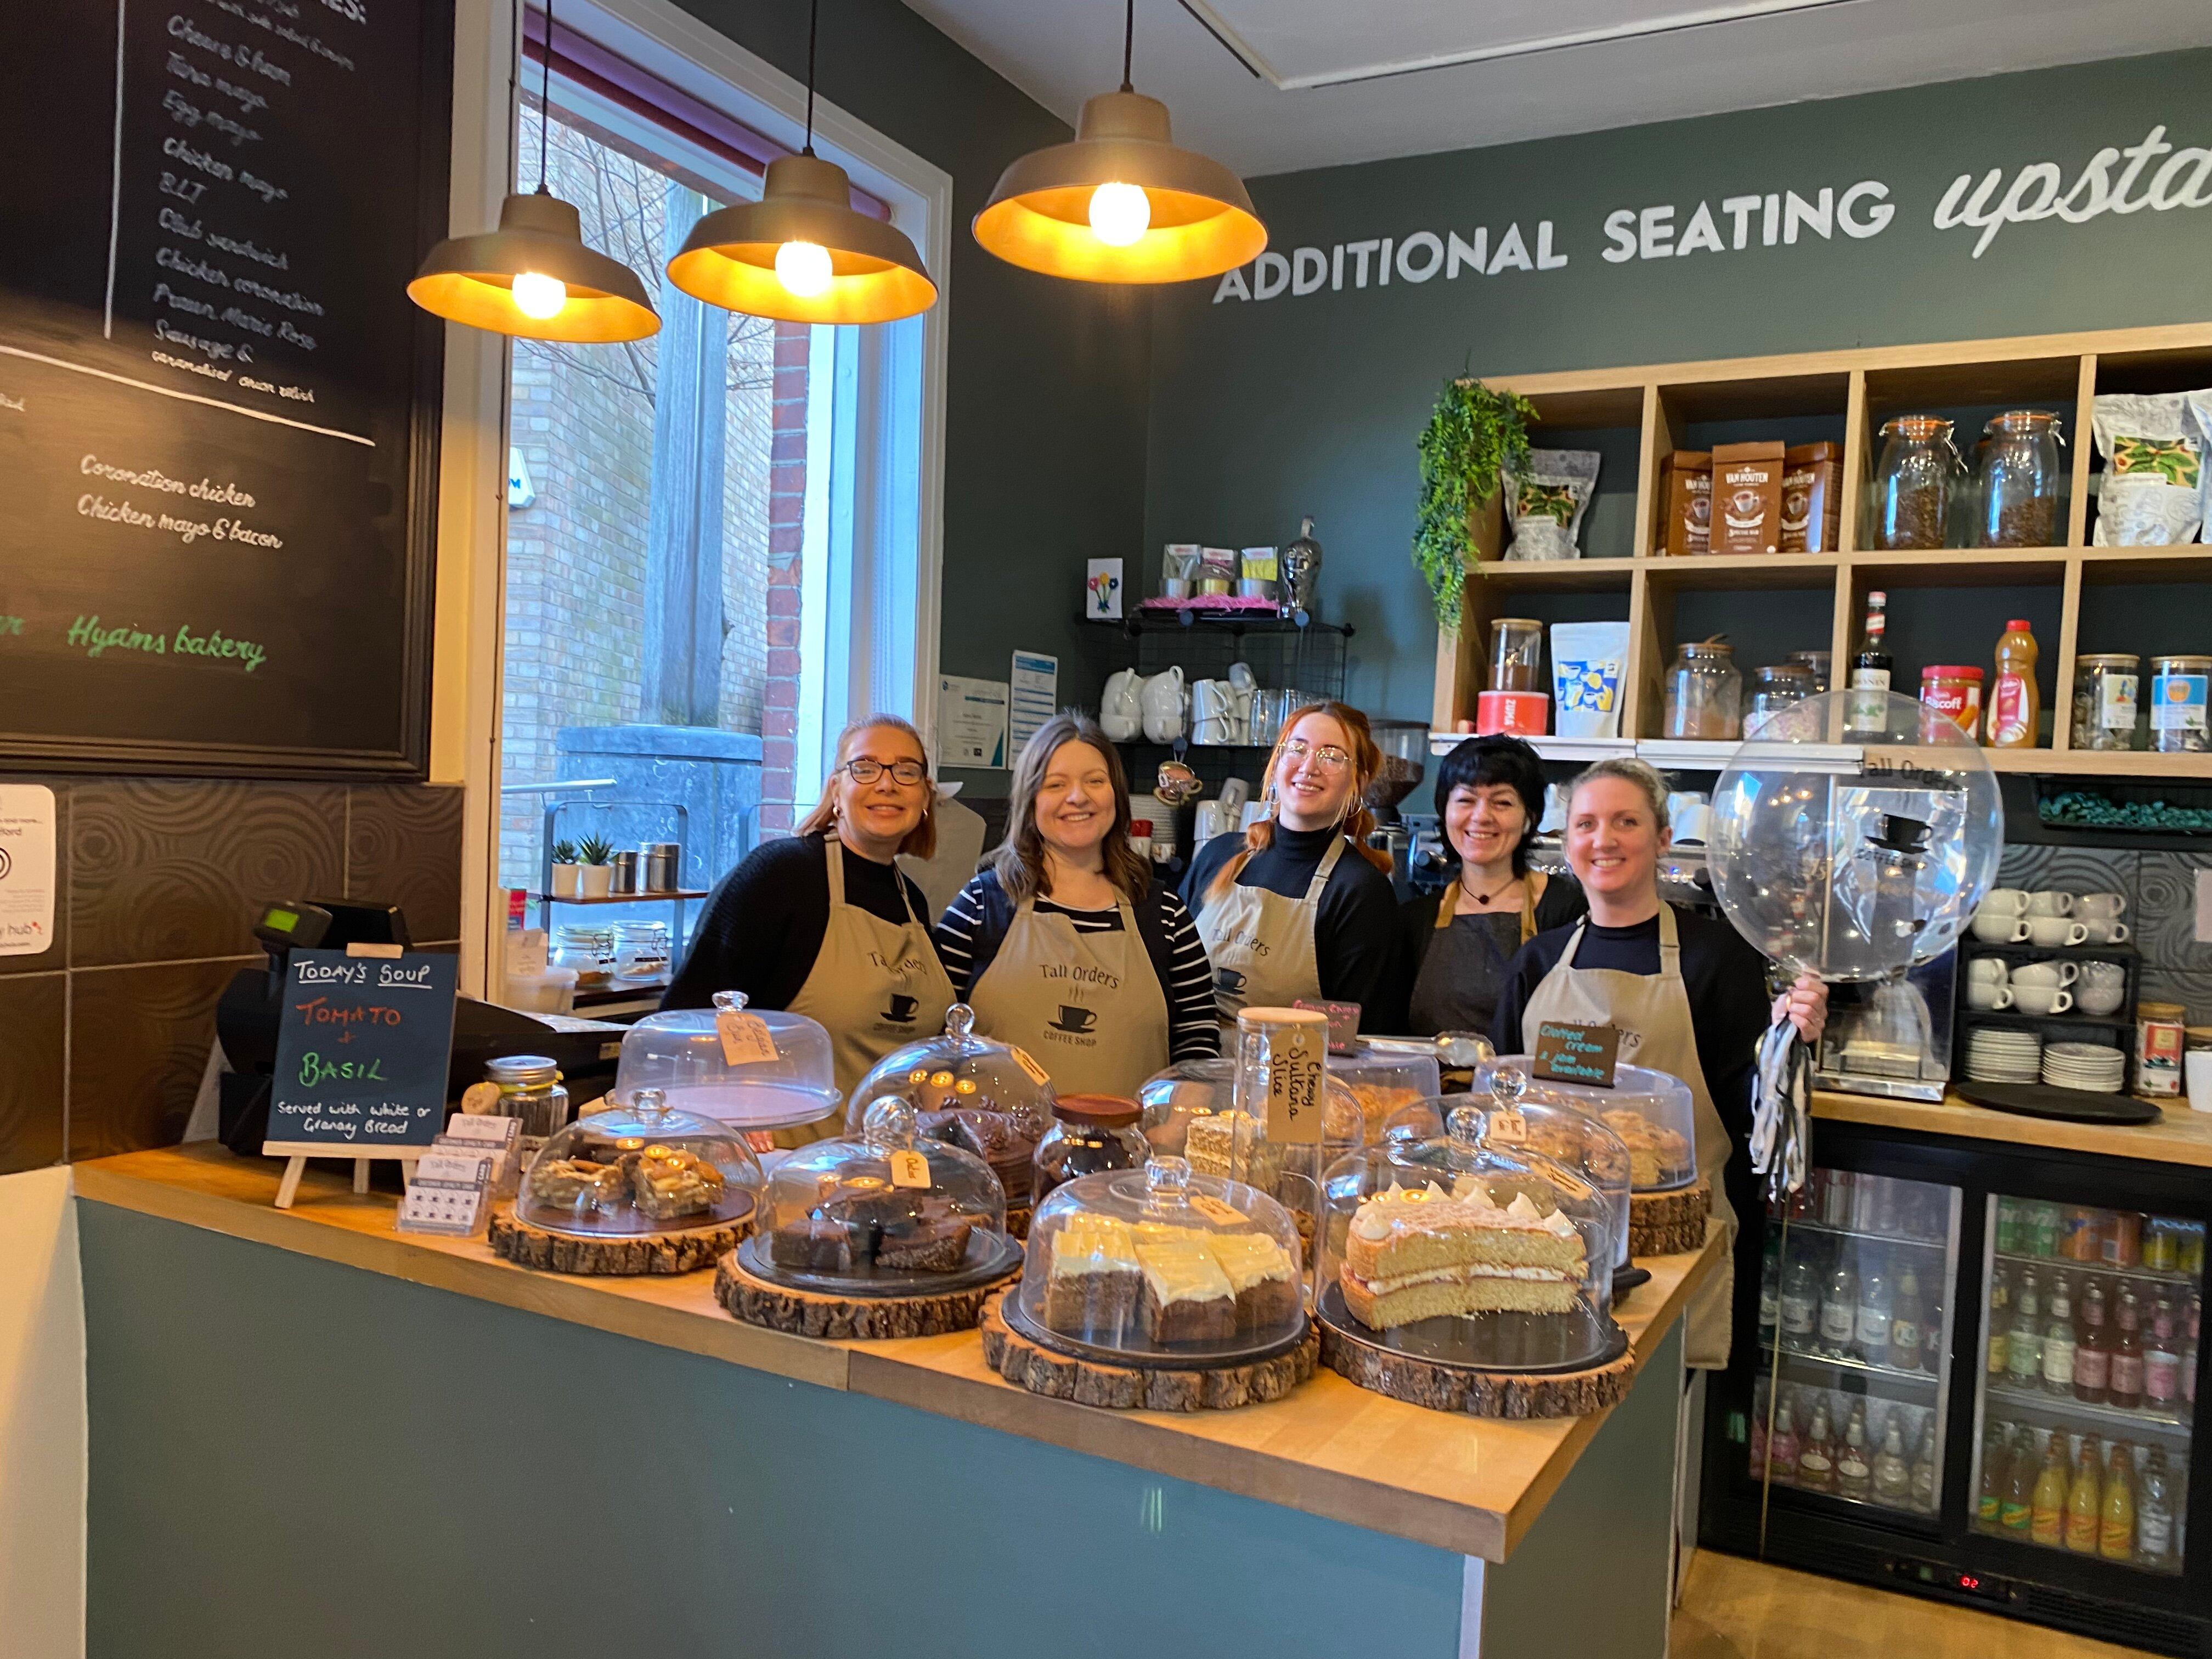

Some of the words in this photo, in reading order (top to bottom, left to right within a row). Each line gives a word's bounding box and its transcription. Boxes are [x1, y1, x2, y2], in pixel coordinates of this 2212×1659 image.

[1212, 221, 1569, 304] ADDITIONAL
[1601, 181, 1896, 264] SEATING
[80, 454, 187, 494] Coronation
[189, 478, 256, 508] chicken
[77, 494, 156, 528] Chicken
[157, 513, 212, 544] mayo
[228, 519, 284, 549] bacon
[173, 624, 267, 673] bakery
[294, 960, 367, 984] TODAY'S
[379, 963, 431, 985] SOUP
[1040, 964, 1068, 979] Tall
[1073, 966, 1119, 990] Orders
[295, 996, 402, 1026] TOMATO
[1043, 1030, 1073, 1045] COFFEE
[298, 1052, 388, 1088] BASIL
[1272, 1053, 1288, 1098] Slice
[1288, 1047, 1309, 1121] Sultana
[277, 1101, 321, 1115] Served
[329, 1102, 361, 1115] with
[370, 1103, 410, 1117] white
[416, 1108, 431, 1117] or
[364, 1119, 409, 1135] Bread
